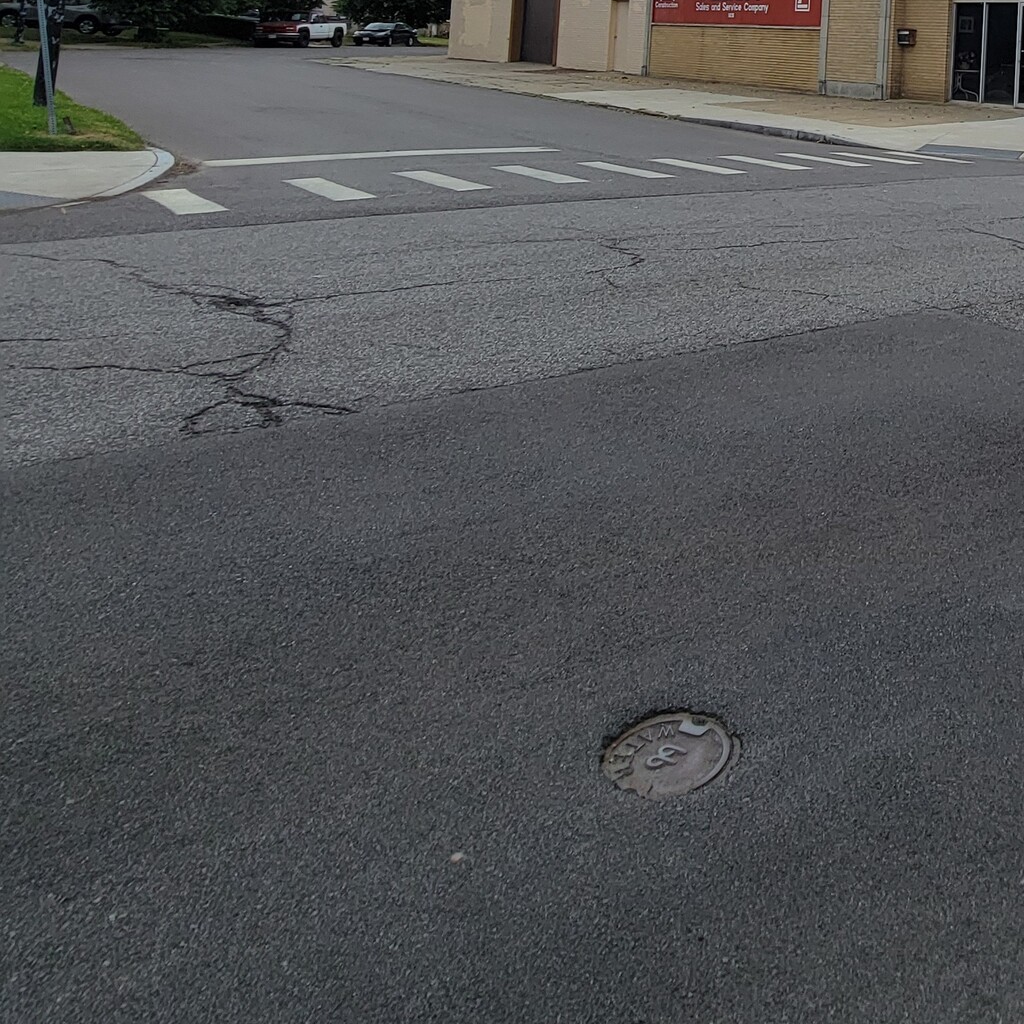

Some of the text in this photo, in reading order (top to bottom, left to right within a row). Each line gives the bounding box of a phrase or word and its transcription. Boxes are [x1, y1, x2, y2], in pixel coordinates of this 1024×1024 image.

[696, 1, 769, 14] Sales and Service Company
